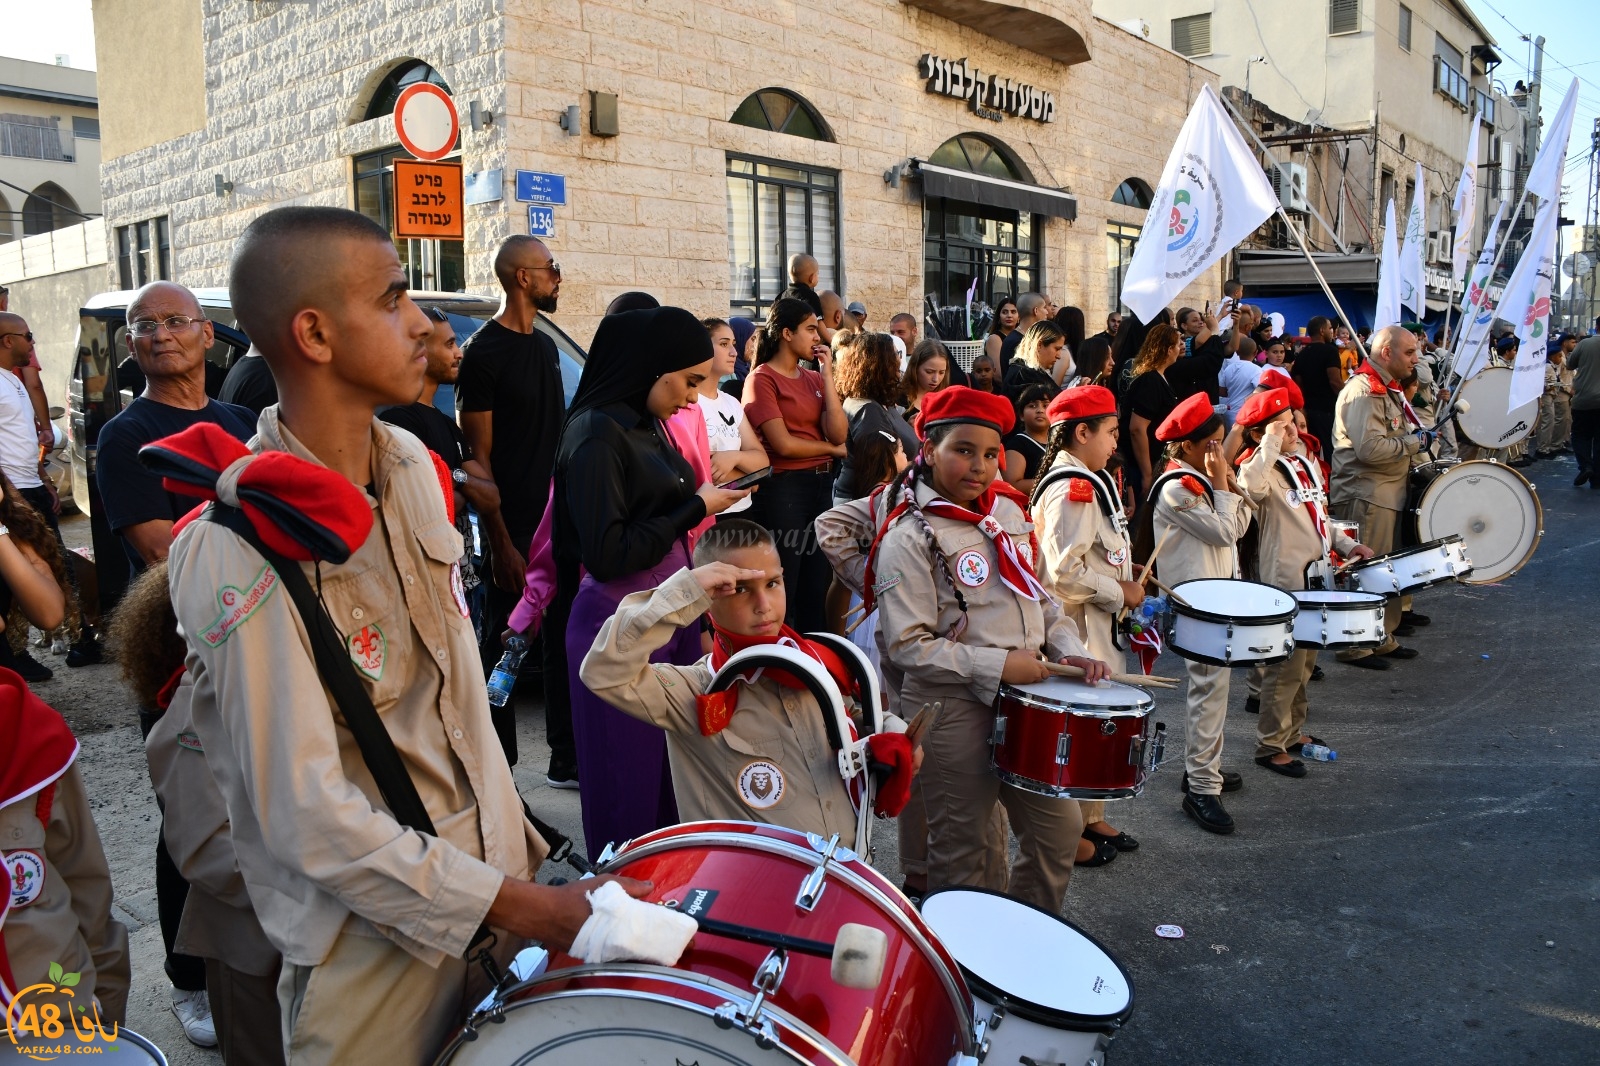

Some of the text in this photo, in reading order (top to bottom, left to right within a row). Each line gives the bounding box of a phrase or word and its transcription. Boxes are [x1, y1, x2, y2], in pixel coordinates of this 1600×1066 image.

[922, 53, 1055, 123] מסעדת קלבוני
[415, 174, 442, 187] פרט
[412, 191, 446, 206] לרכב
[408, 212, 451, 226] עבודה
[532, 212, 552, 229] 136
[687, 889, 708, 916] egend
